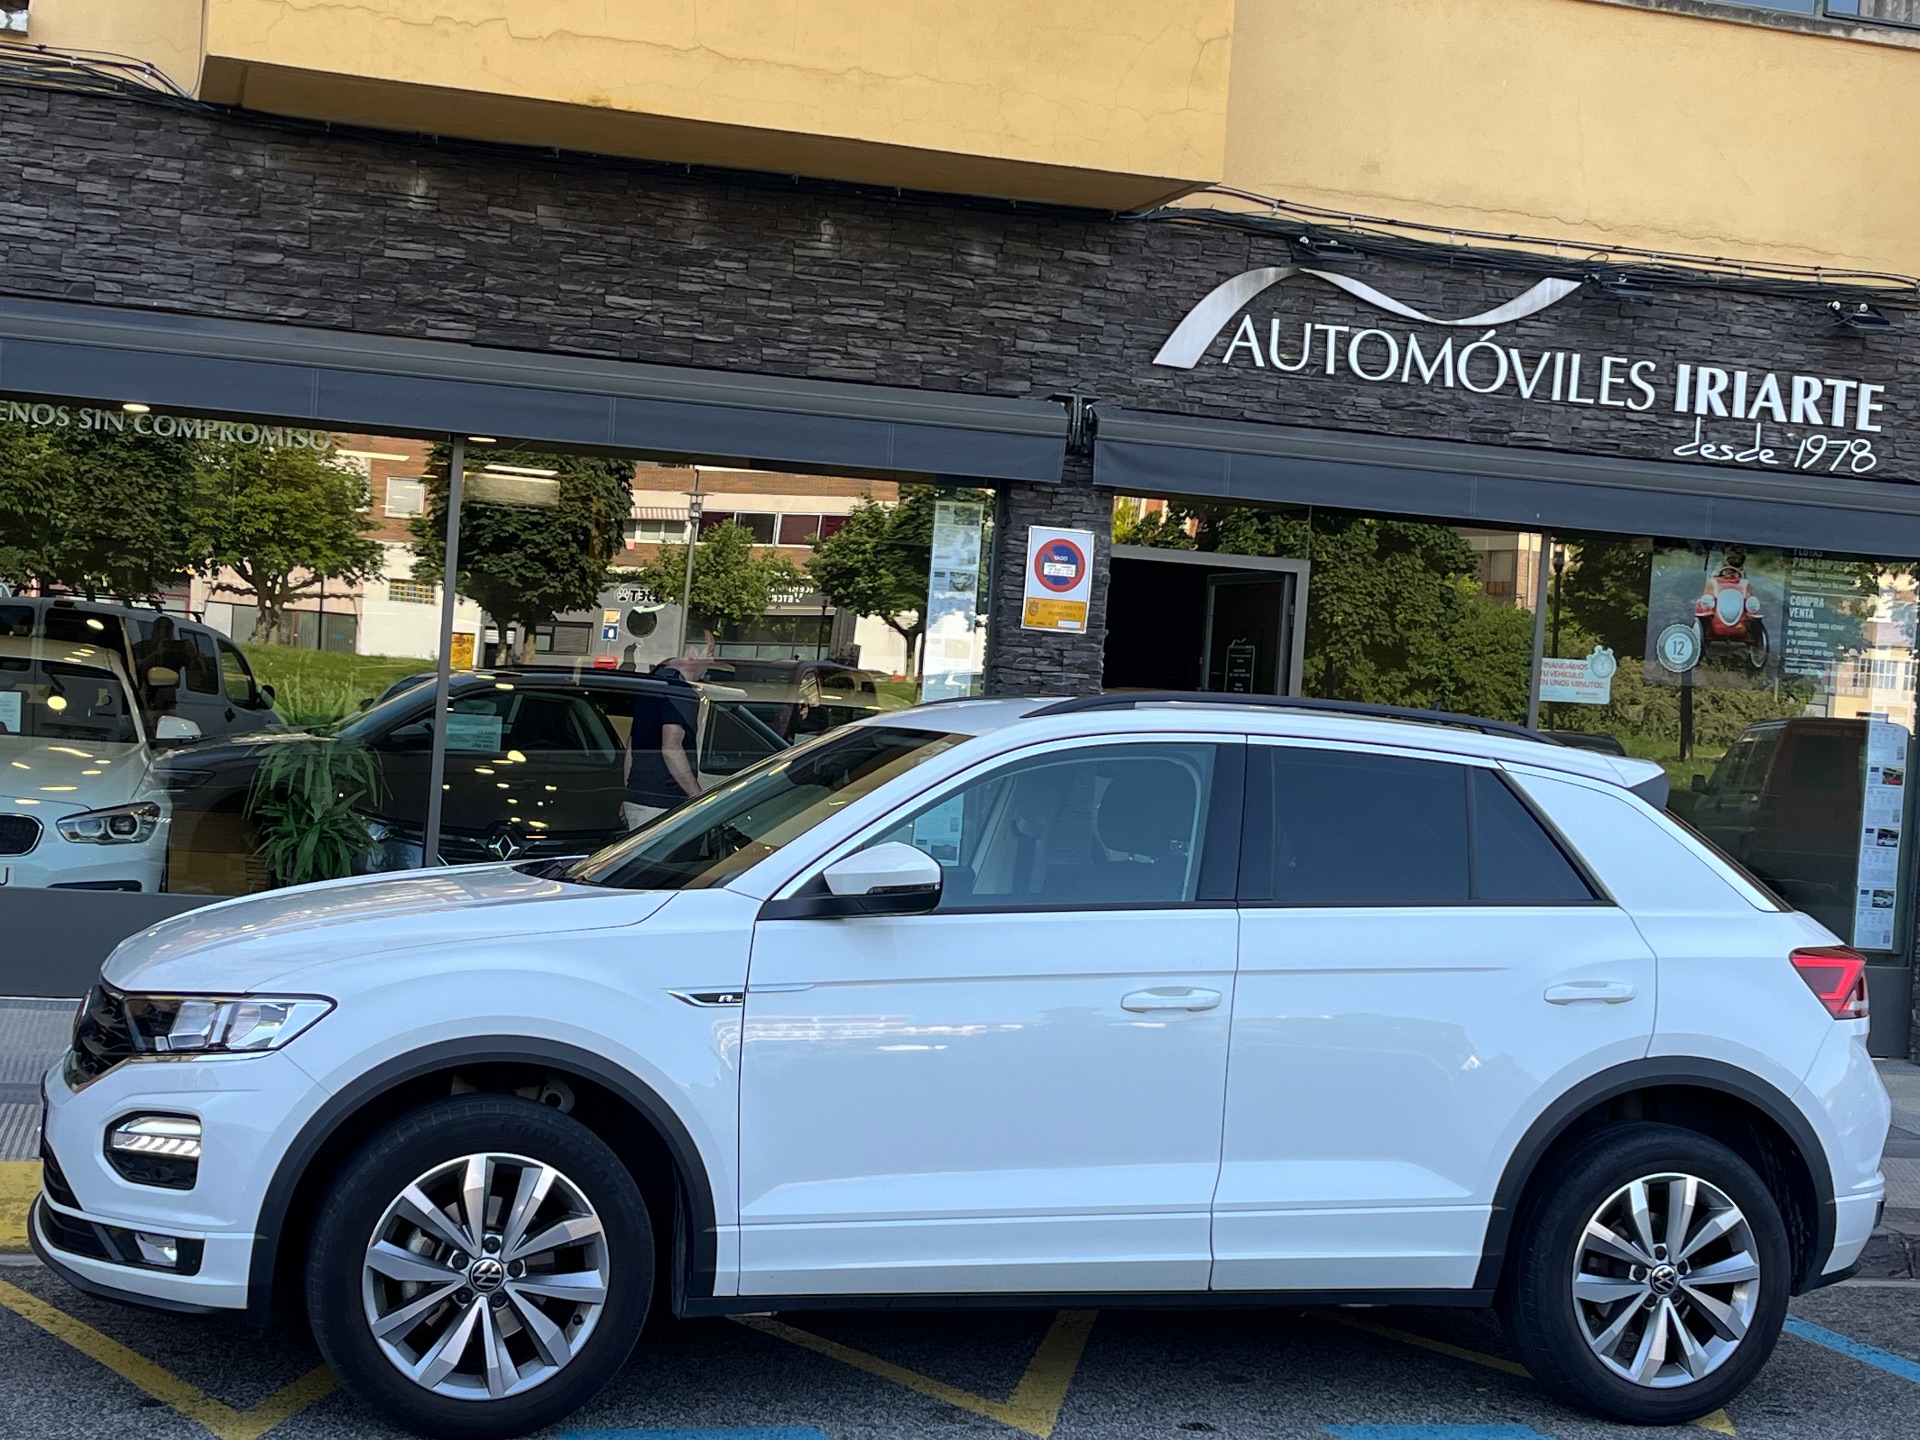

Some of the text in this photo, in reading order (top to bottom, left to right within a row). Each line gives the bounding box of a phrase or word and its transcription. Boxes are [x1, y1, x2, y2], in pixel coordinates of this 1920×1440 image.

[1222, 314, 1885, 432] AUTOMÓVILES IRIARTE
[78, 407, 124, 432] SIN
[134, 413, 332, 451] COMPROMISO
[1672, 416, 1877, 473] desde 1978
[1790, 595, 1824, 608] COMPRA
[1789, 607, 1814, 619] VENTA
[1672, 640, 1685, 656] 12
[1542, 662, 1588, 670] INANCIAMOS
